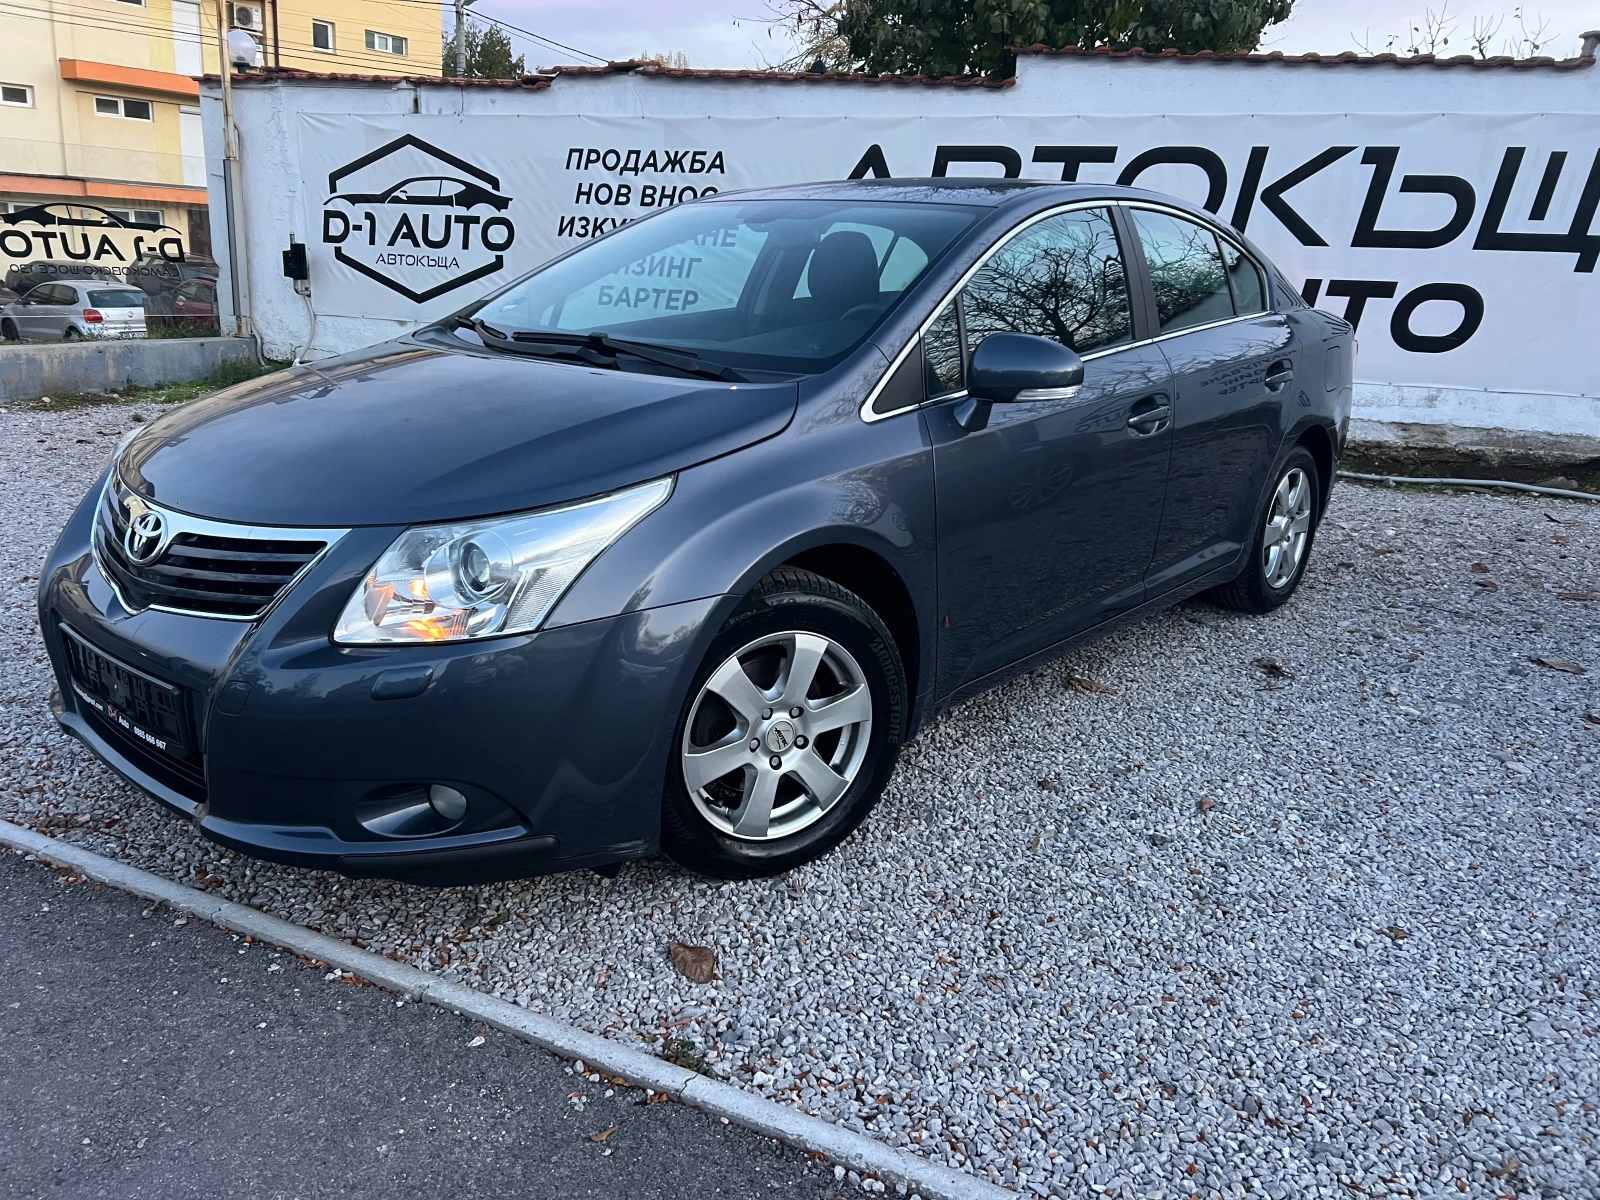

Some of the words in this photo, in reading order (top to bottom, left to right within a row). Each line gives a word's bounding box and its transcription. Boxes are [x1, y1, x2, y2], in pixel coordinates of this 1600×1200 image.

[565, 148, 725, 176] ПРОДАЖБА
[575, 183, 632, 205] НОВ
[323, 210, 376, 246] D-1
[387, 212, 515, 252] AUTO
[375, 253, 460, 270] АВТОКЪЩА
[597, 285, 699, 311] БАРТЕР
[868, 637, 902, 744] BRIDGESTONE
